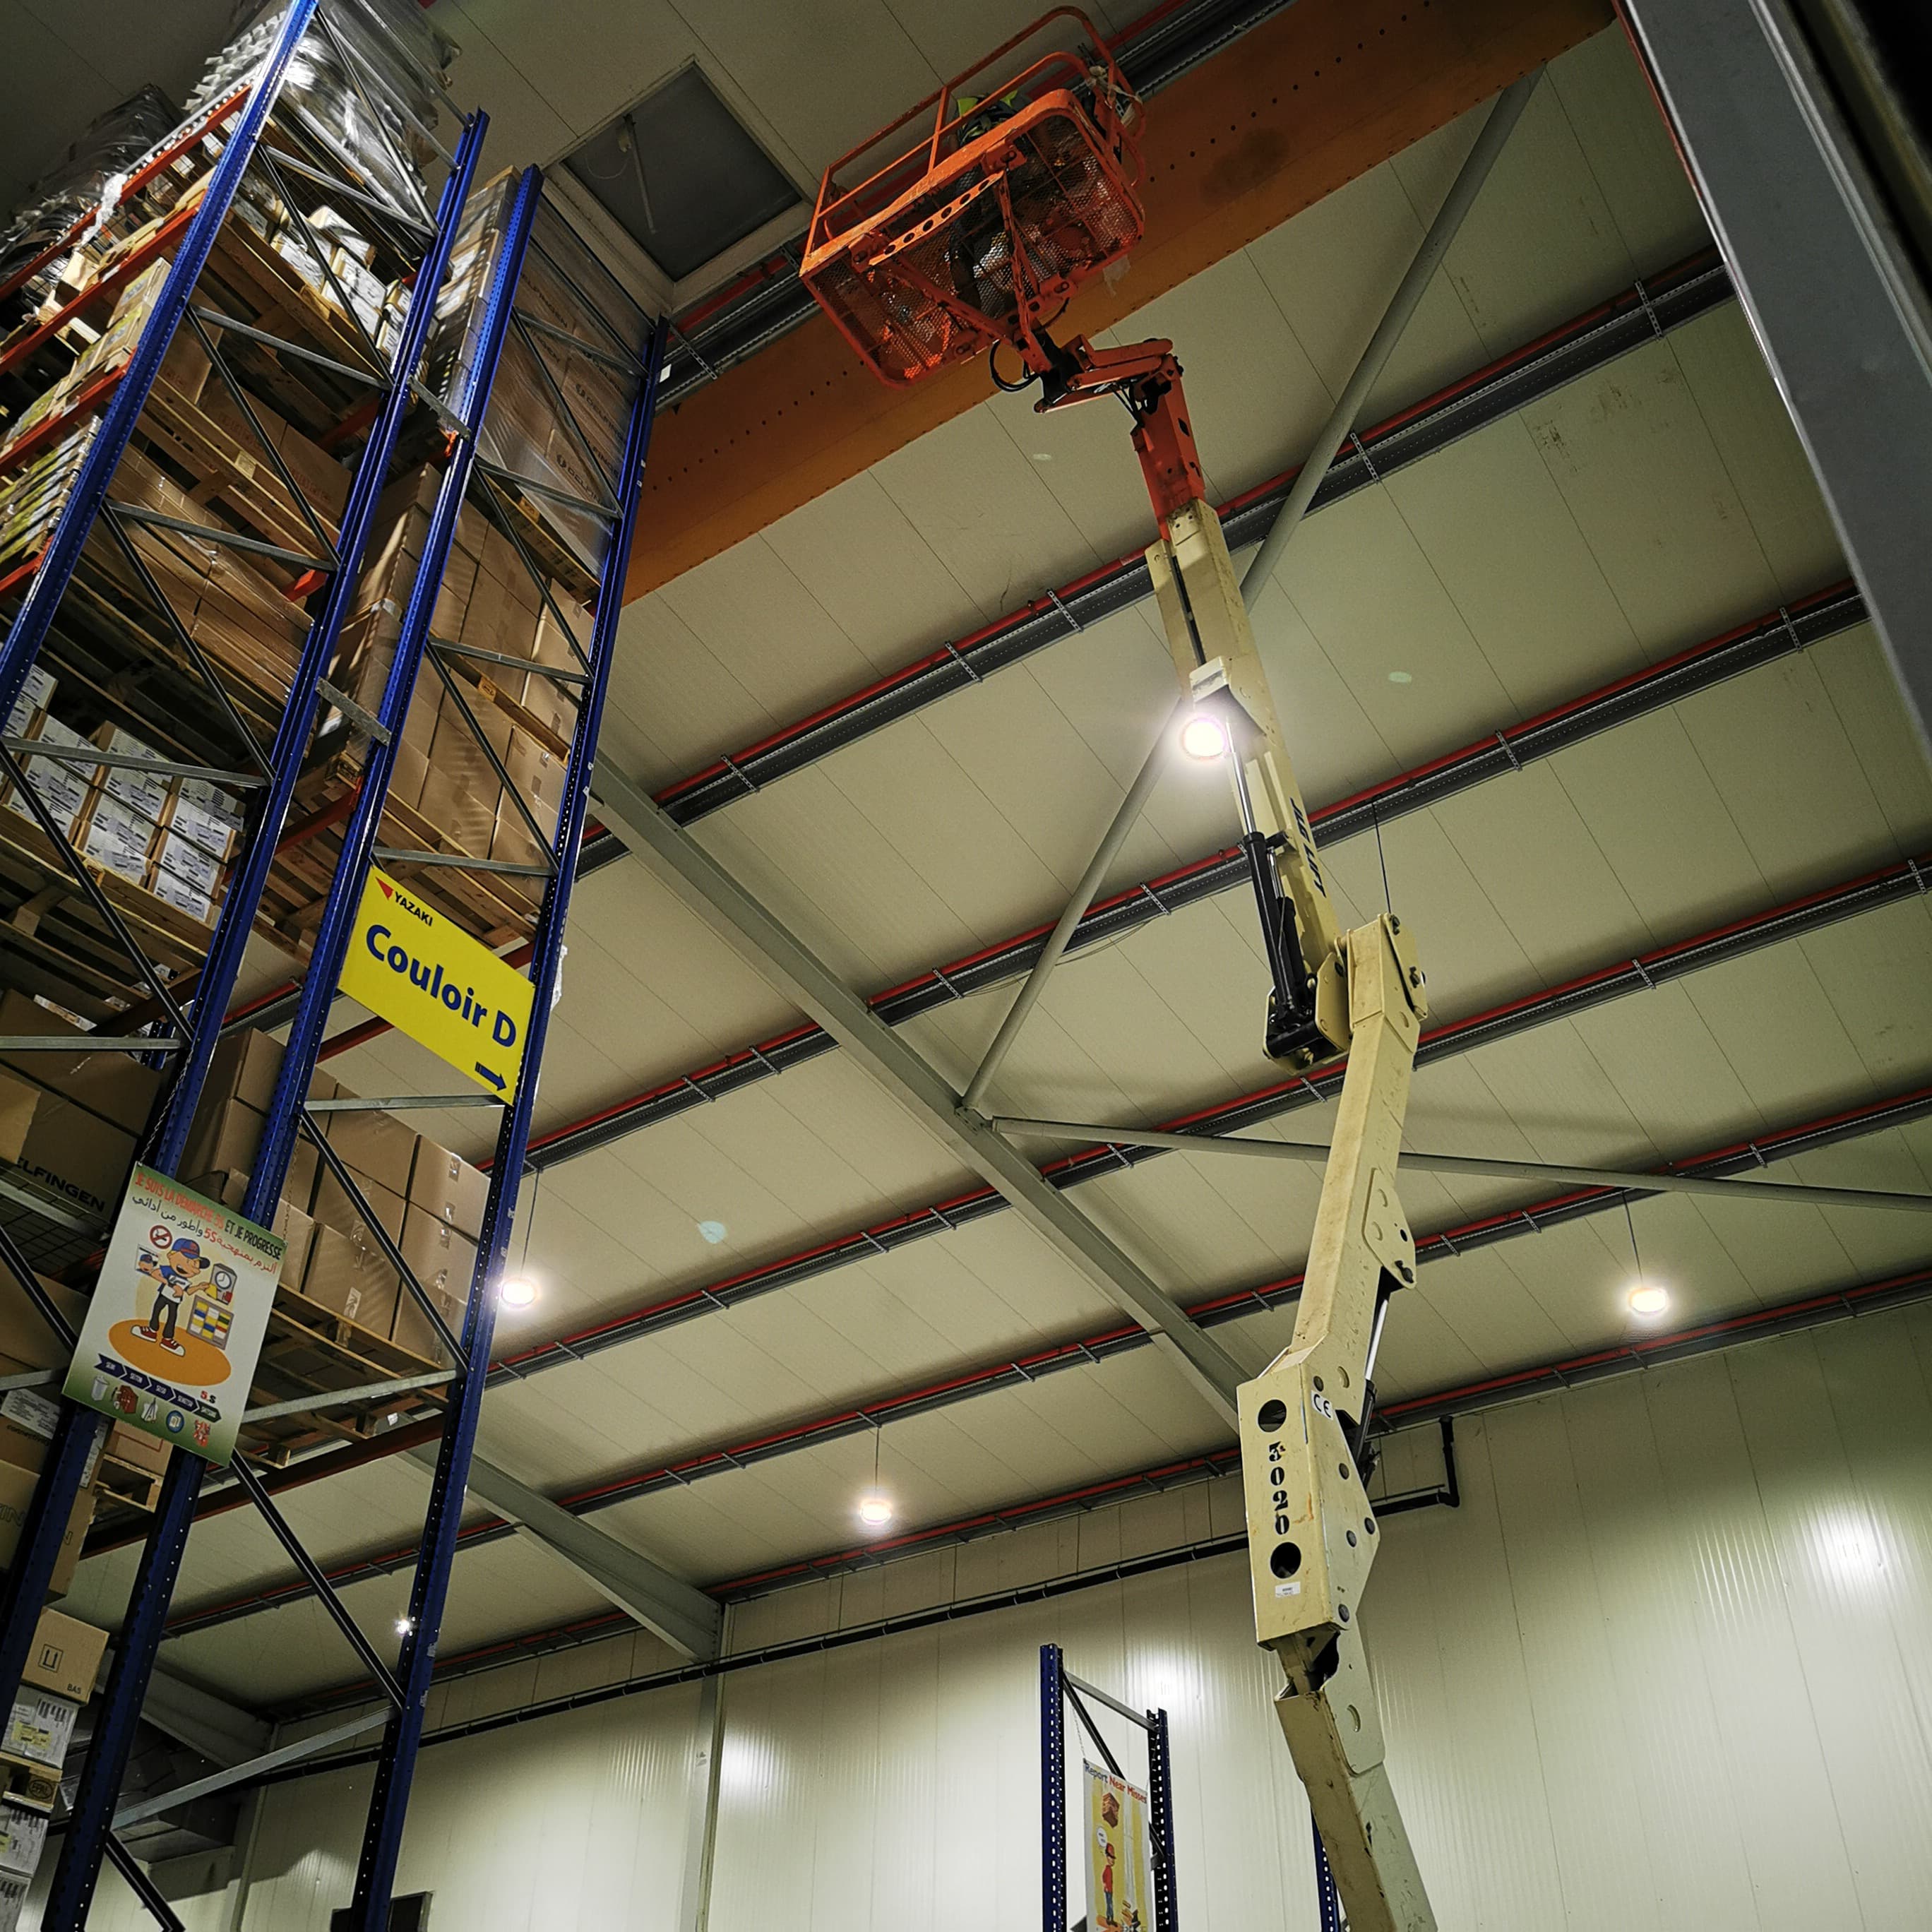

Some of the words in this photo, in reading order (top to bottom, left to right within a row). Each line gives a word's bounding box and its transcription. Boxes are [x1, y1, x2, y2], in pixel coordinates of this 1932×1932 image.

[394, 891, 433, 927] YAZAKI
[366, 924, 488, 1028] Couloir
[491, 1010, 517, 1047] D
[16, 1156, 105, 1212] ELFINGEN
[144, 1176, 165, 1196] SUIS
[162, 1187, 175, 1203] LA
[225, 1220, 235, 1234] ET
[233, 1224, 244, 1239] JE
[242, 1230, 283, 1260] PROGRESSE
[1313, 1393, 1332, 1419] CE
[67, 1683, 82, 1695] BAS
[1085, 1765, 1108, 1783] Report
[1109, 1775, 1126, 1791] Near
[1127, 1785, 1147, 1804] Misses
